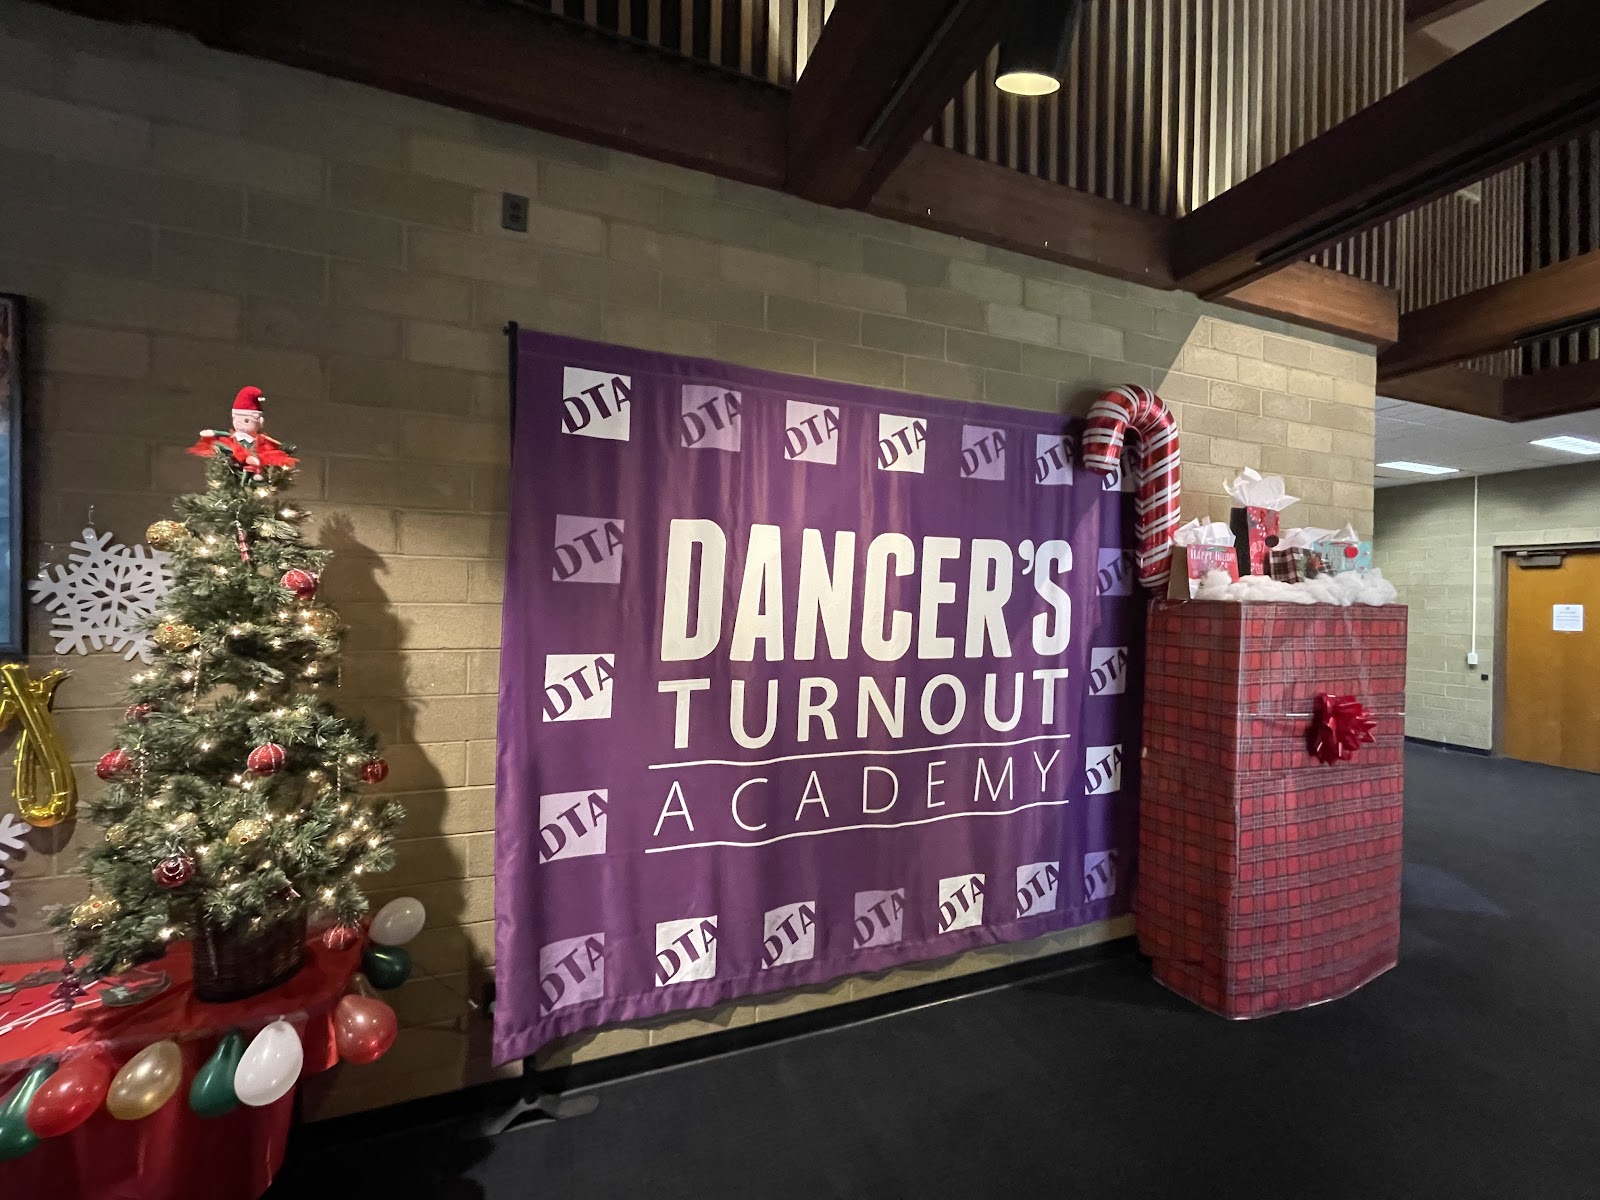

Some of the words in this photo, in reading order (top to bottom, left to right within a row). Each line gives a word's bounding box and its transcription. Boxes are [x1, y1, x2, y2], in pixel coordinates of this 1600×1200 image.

[562, 375, 631, 434] DTA
[681, 391, 742, 447] DTA
[785, 408, 840, 459] DTA
[878, 420, 927, 469] DTA
[961, 430, 1006, 477] DTA
[1035, 436, 1074, 483] DTA
[552, 520, 624, 581] DTA
[660, 518, 1073, 662] DANCER'S
[543, 655, 614, 721] DTA
[1089, 648, 1128, 694] DTA
[657, 668, 1069, 749] TURNOUT
[653, 749, 1061, 836] ACADEMY
[1085, 747, 1123, 793] DTA
[539, 792, 607, 862] DTA
[938, 875, 985, 931] DTA
[1016, 862, 1060, 916] DTA
[763, 903, 815, 967] DTA
[853, 891, 904, 946] DTA
[540, 936, 604, 1013] DTA
[655, 919, 717, 985] DTA
